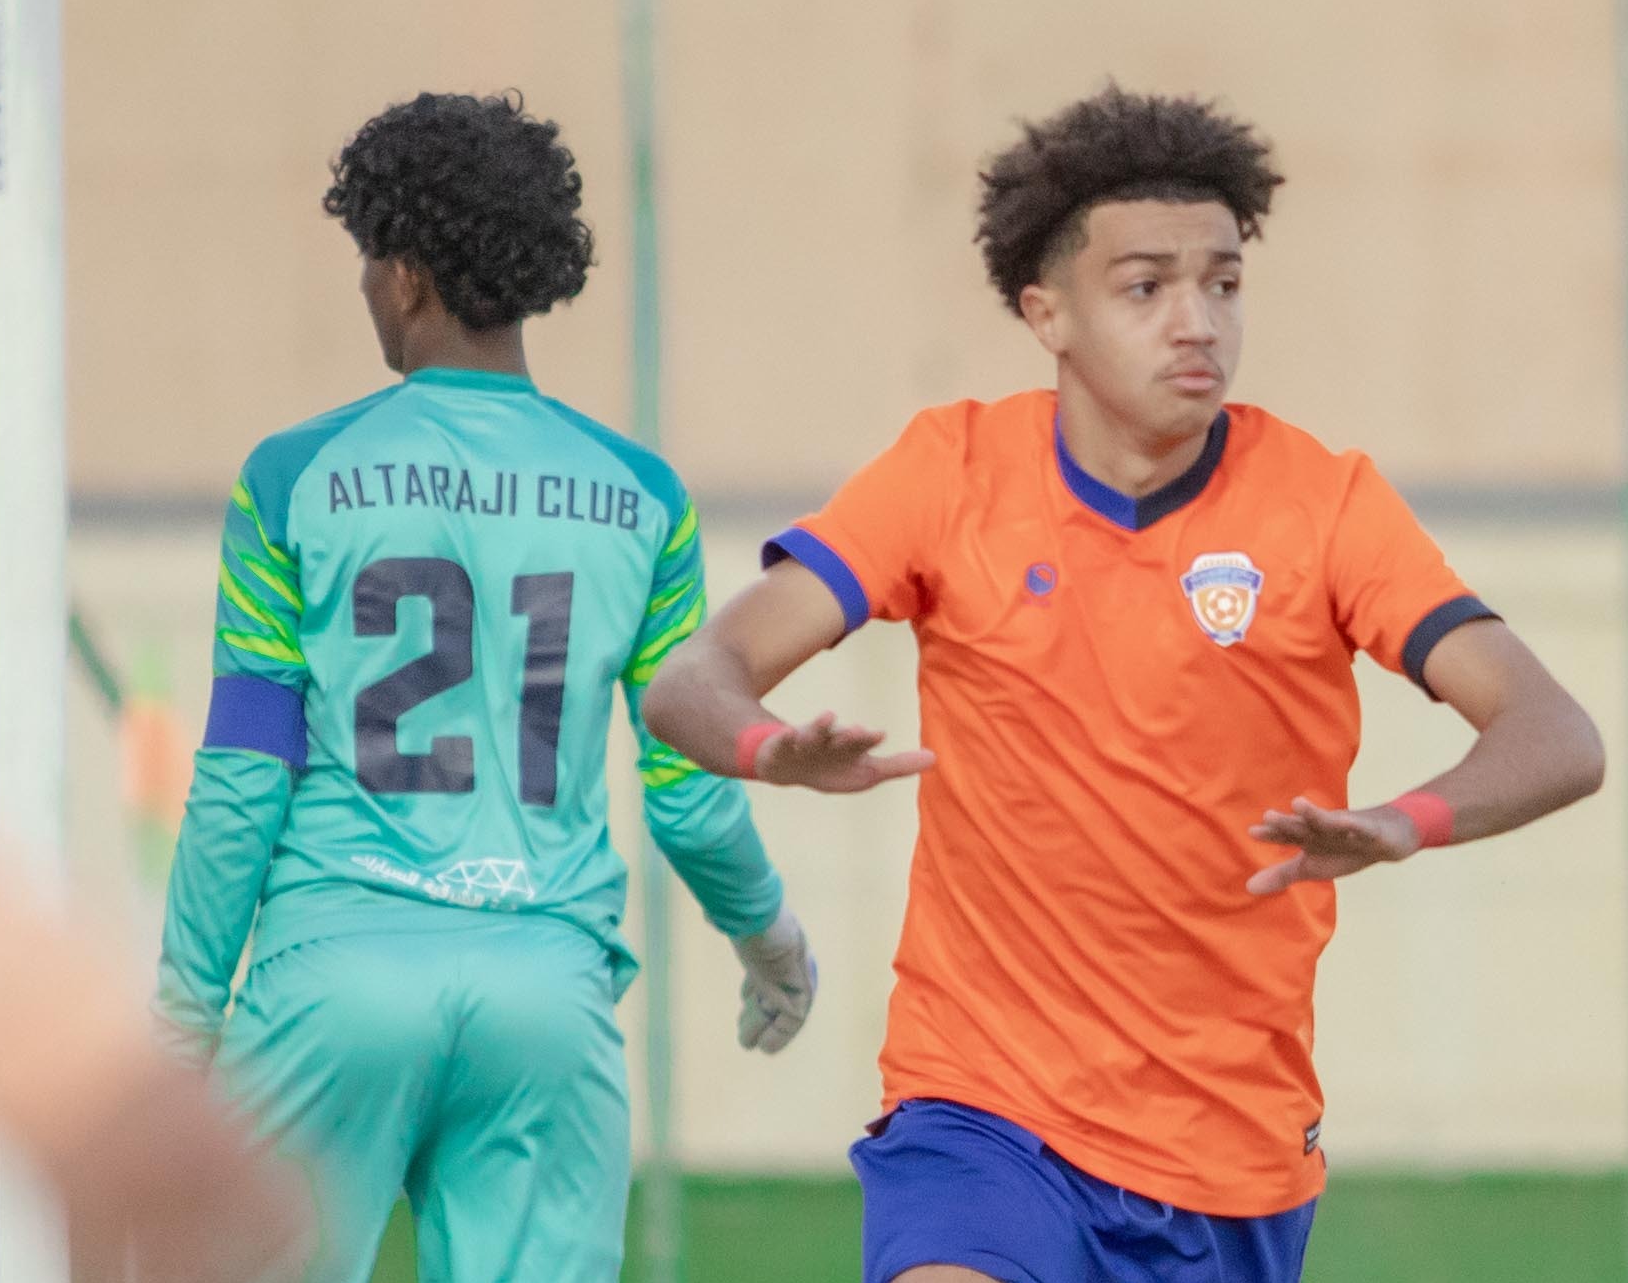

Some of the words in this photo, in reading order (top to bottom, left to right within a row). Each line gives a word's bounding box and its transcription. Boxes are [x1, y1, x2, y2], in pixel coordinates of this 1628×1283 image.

[328, 463, 518, 517] ALTARAJI
[536, 474, 640, 531] CLUB
[352, 556, 575, 808] 21
